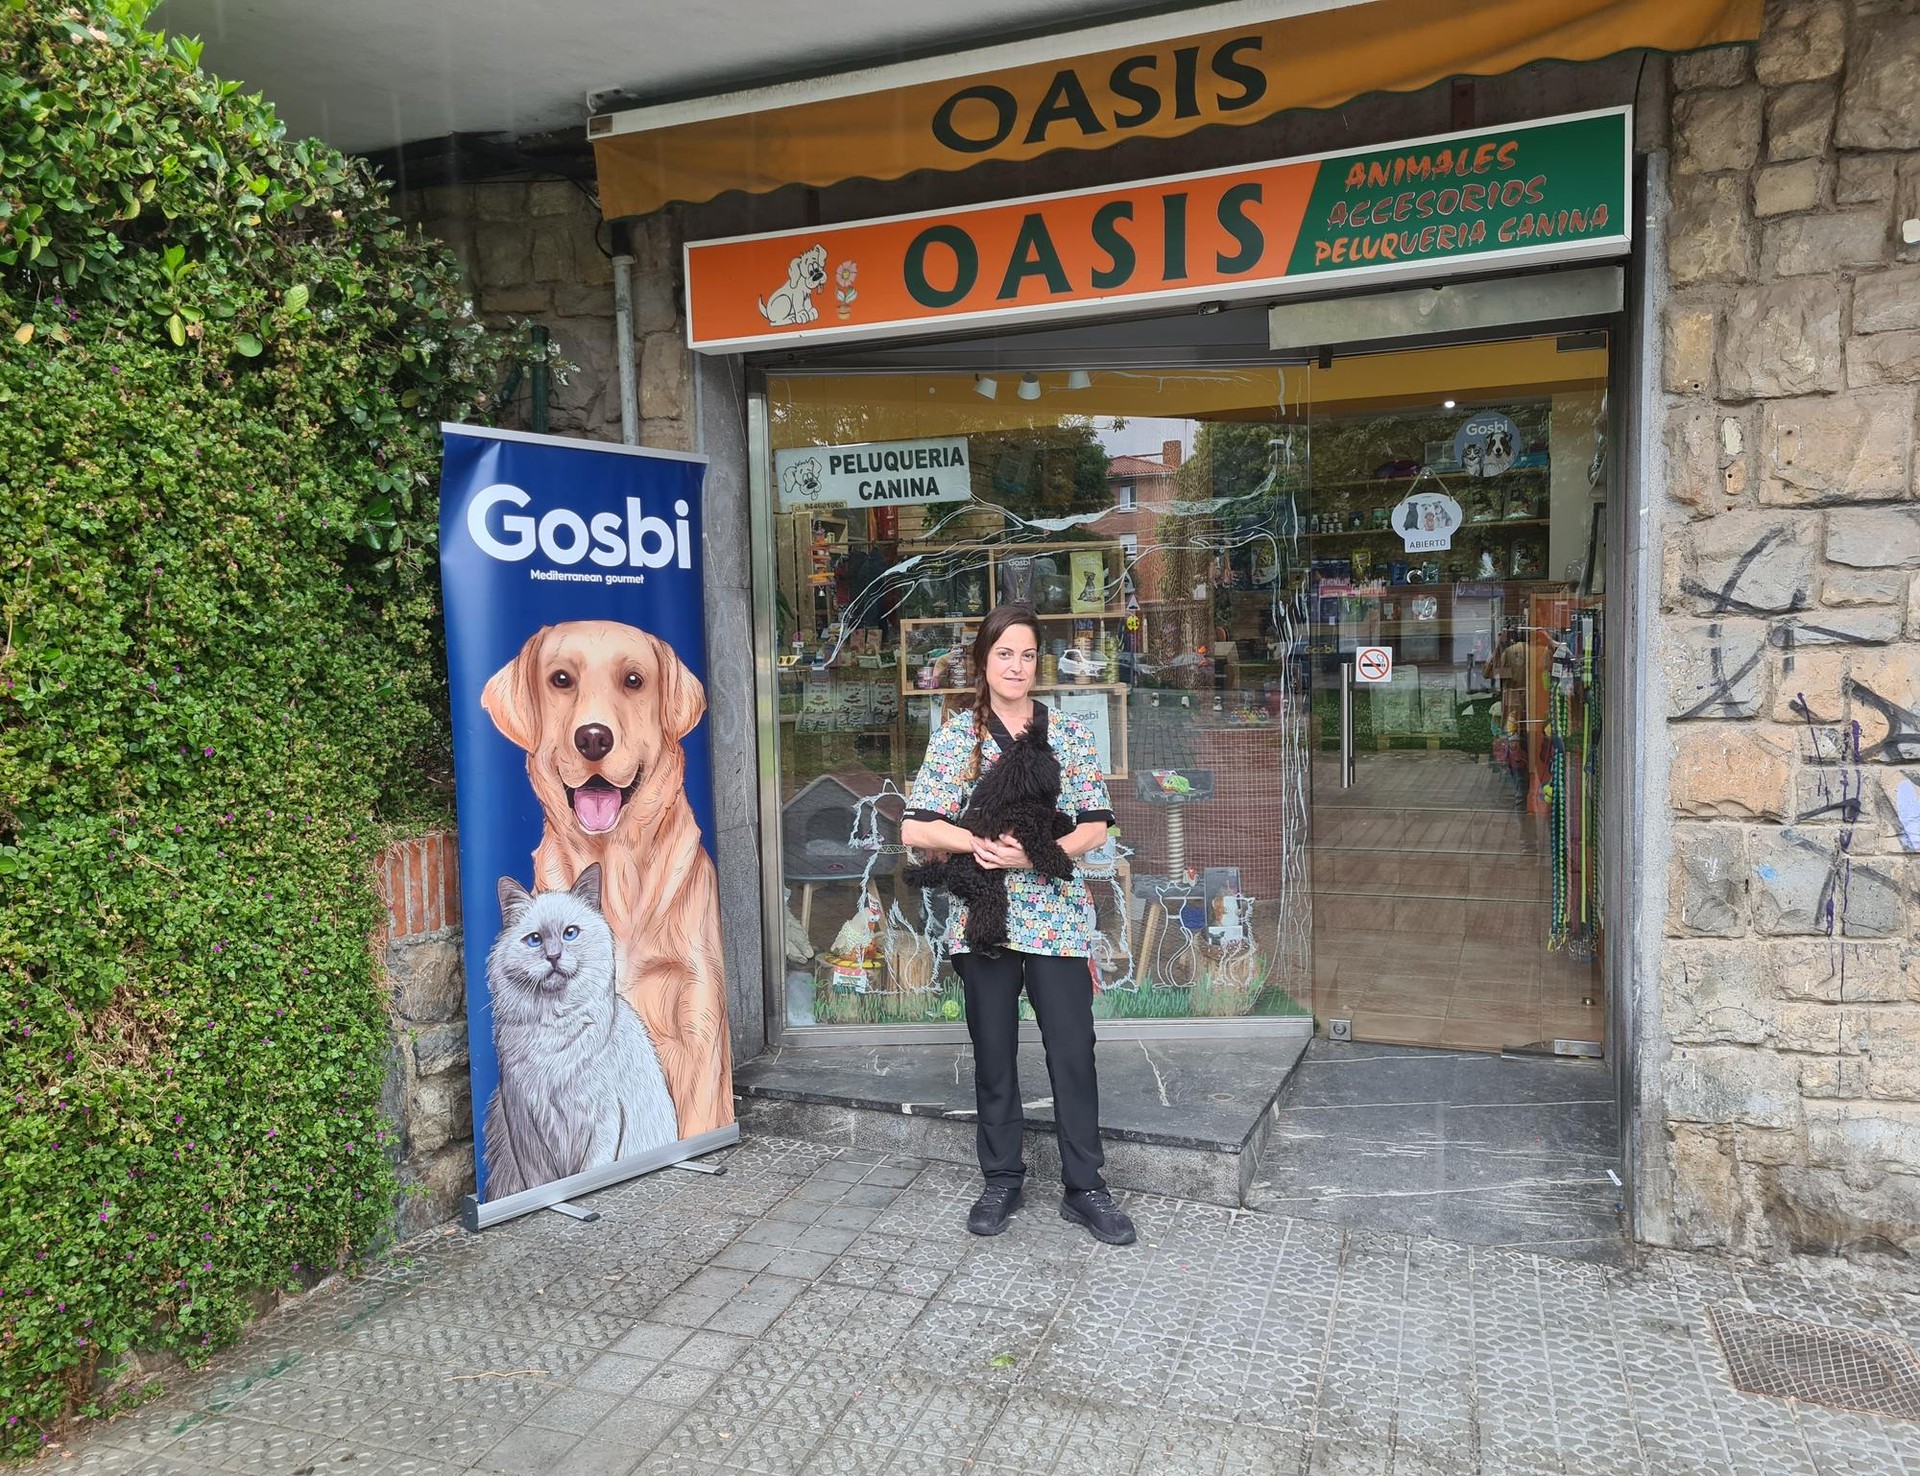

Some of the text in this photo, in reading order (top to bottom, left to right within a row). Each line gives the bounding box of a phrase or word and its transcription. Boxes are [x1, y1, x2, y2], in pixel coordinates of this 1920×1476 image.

[932, 36, 1267, 154] OASIS
[1345, 140, 1519, 192] ANIMALES
[1327, 174, 1547, 231] ACCESORIOS
[903, 182, 1265, 309] OASIS
[1315, 203, 1610, 266] PELUQUERIA CANINA
[1466, 420, 1508, 436] Gosbi
[829, 446, 965, 475] PELUQUERIA
[858, 476, 940, 501] CANINA
[466, 483, 692, 570] Gosbi
[1409, 539, 1446, 549] ABIERTO
[530, 568, 645, 585] Mediterranean gourmet
